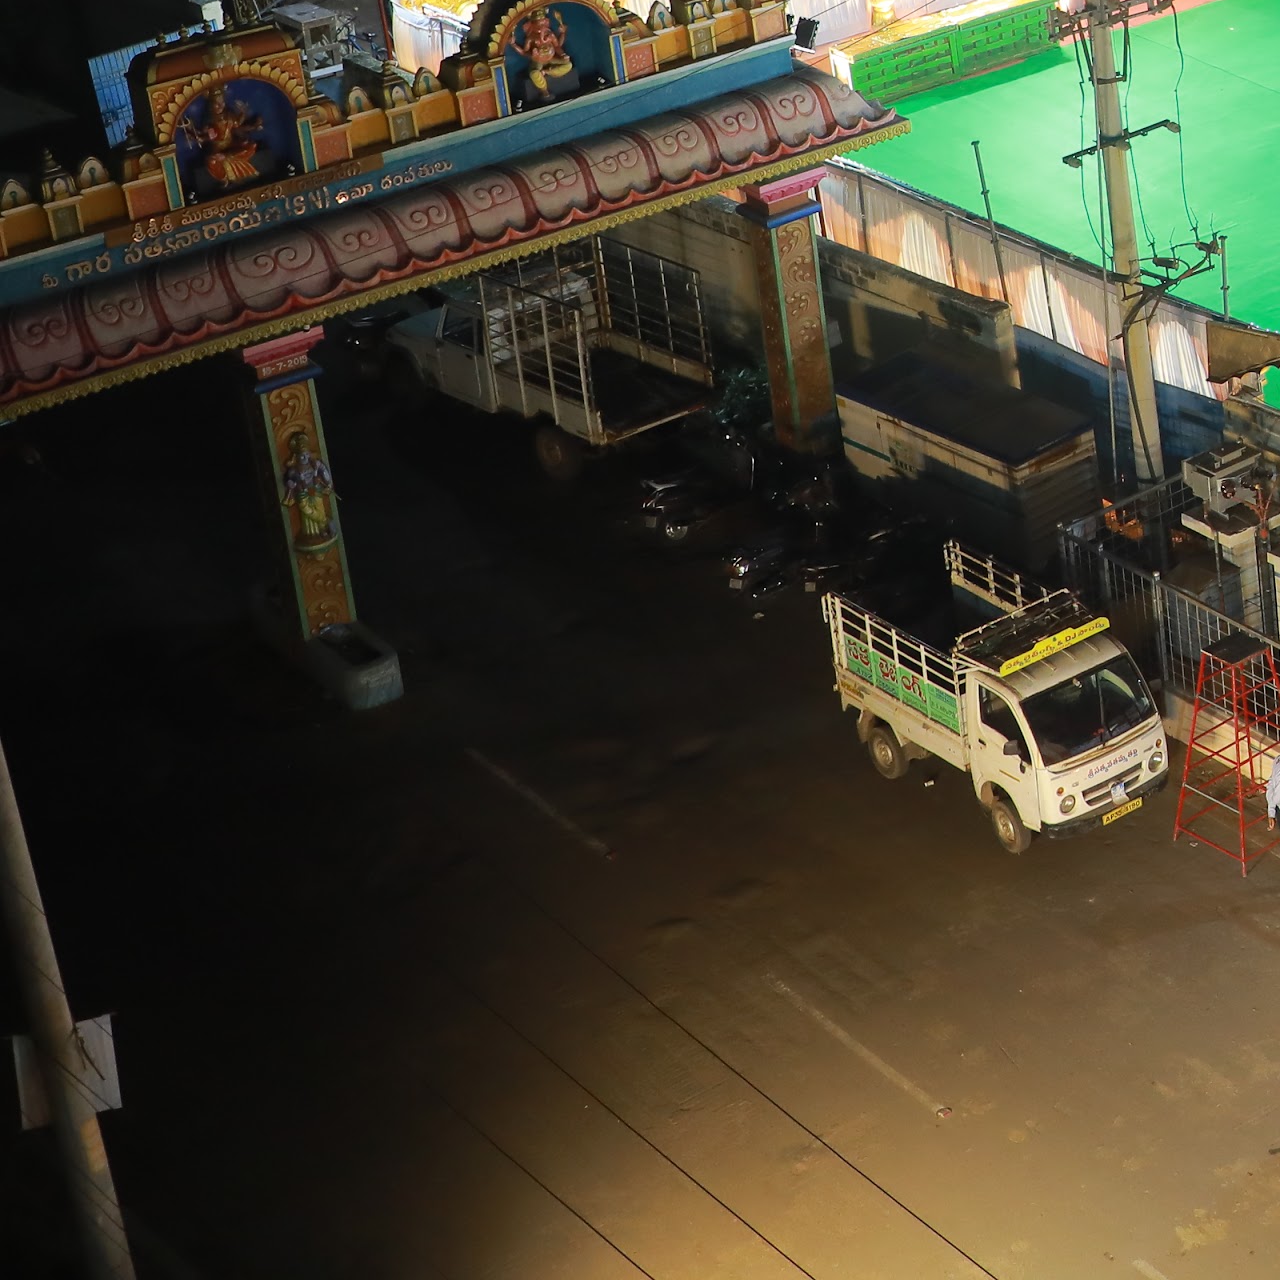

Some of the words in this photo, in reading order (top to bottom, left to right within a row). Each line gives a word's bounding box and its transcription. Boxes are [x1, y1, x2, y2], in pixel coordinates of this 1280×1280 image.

[64, 251, 112, 281] గార
[335, 183, 375, 205] ఉమా
[380, 159, 453, 190] దంపతులు
[1065, 632, 1077, 642] DJ
